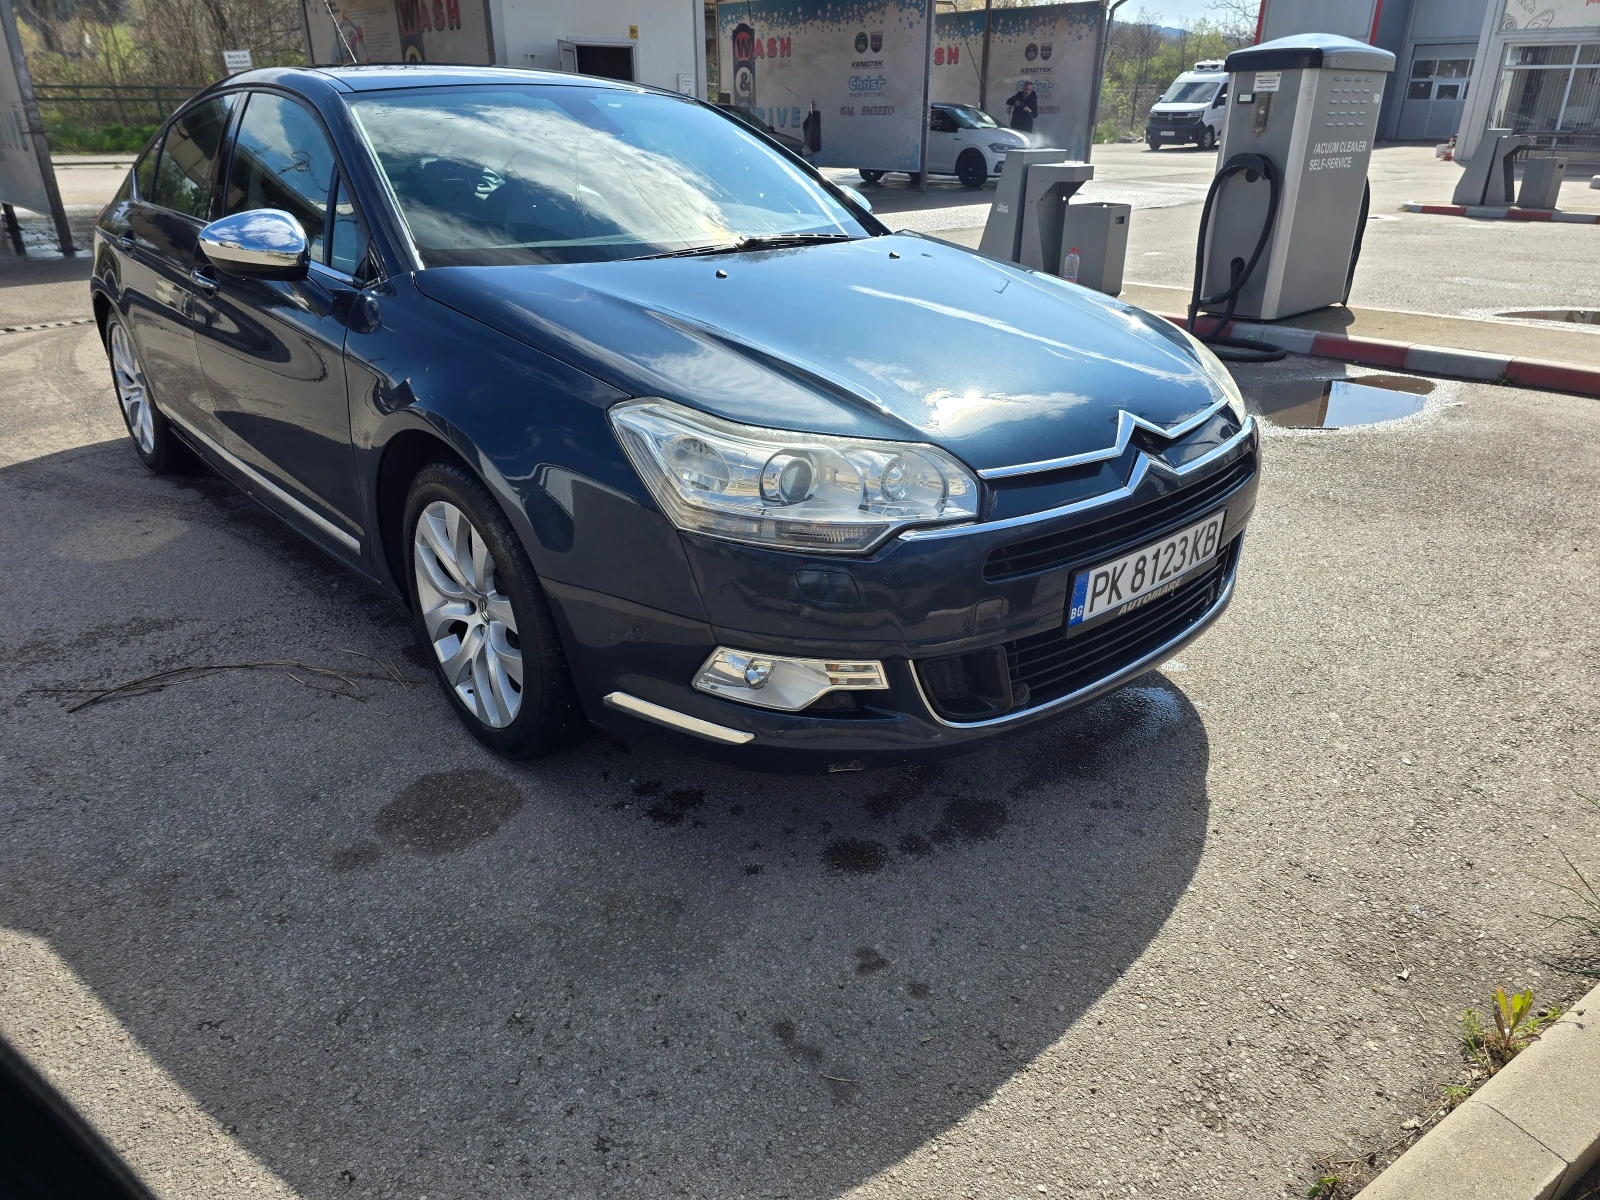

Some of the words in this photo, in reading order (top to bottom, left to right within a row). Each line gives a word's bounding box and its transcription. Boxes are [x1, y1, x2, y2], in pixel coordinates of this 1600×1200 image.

[399, 0, 462, 34] WASH
[736, 36, 791, 59] WASH
[933, 46, 960, 66] SH
[848, 75, 887, 91] Christ
[754, 106, 801, 129] RIVE
[1308, 156, 1352, 171] SELF-SERVICE
[1117, 577, 1183, 616] AUTOMARE
[1070, 605, 1083, 619] BG
